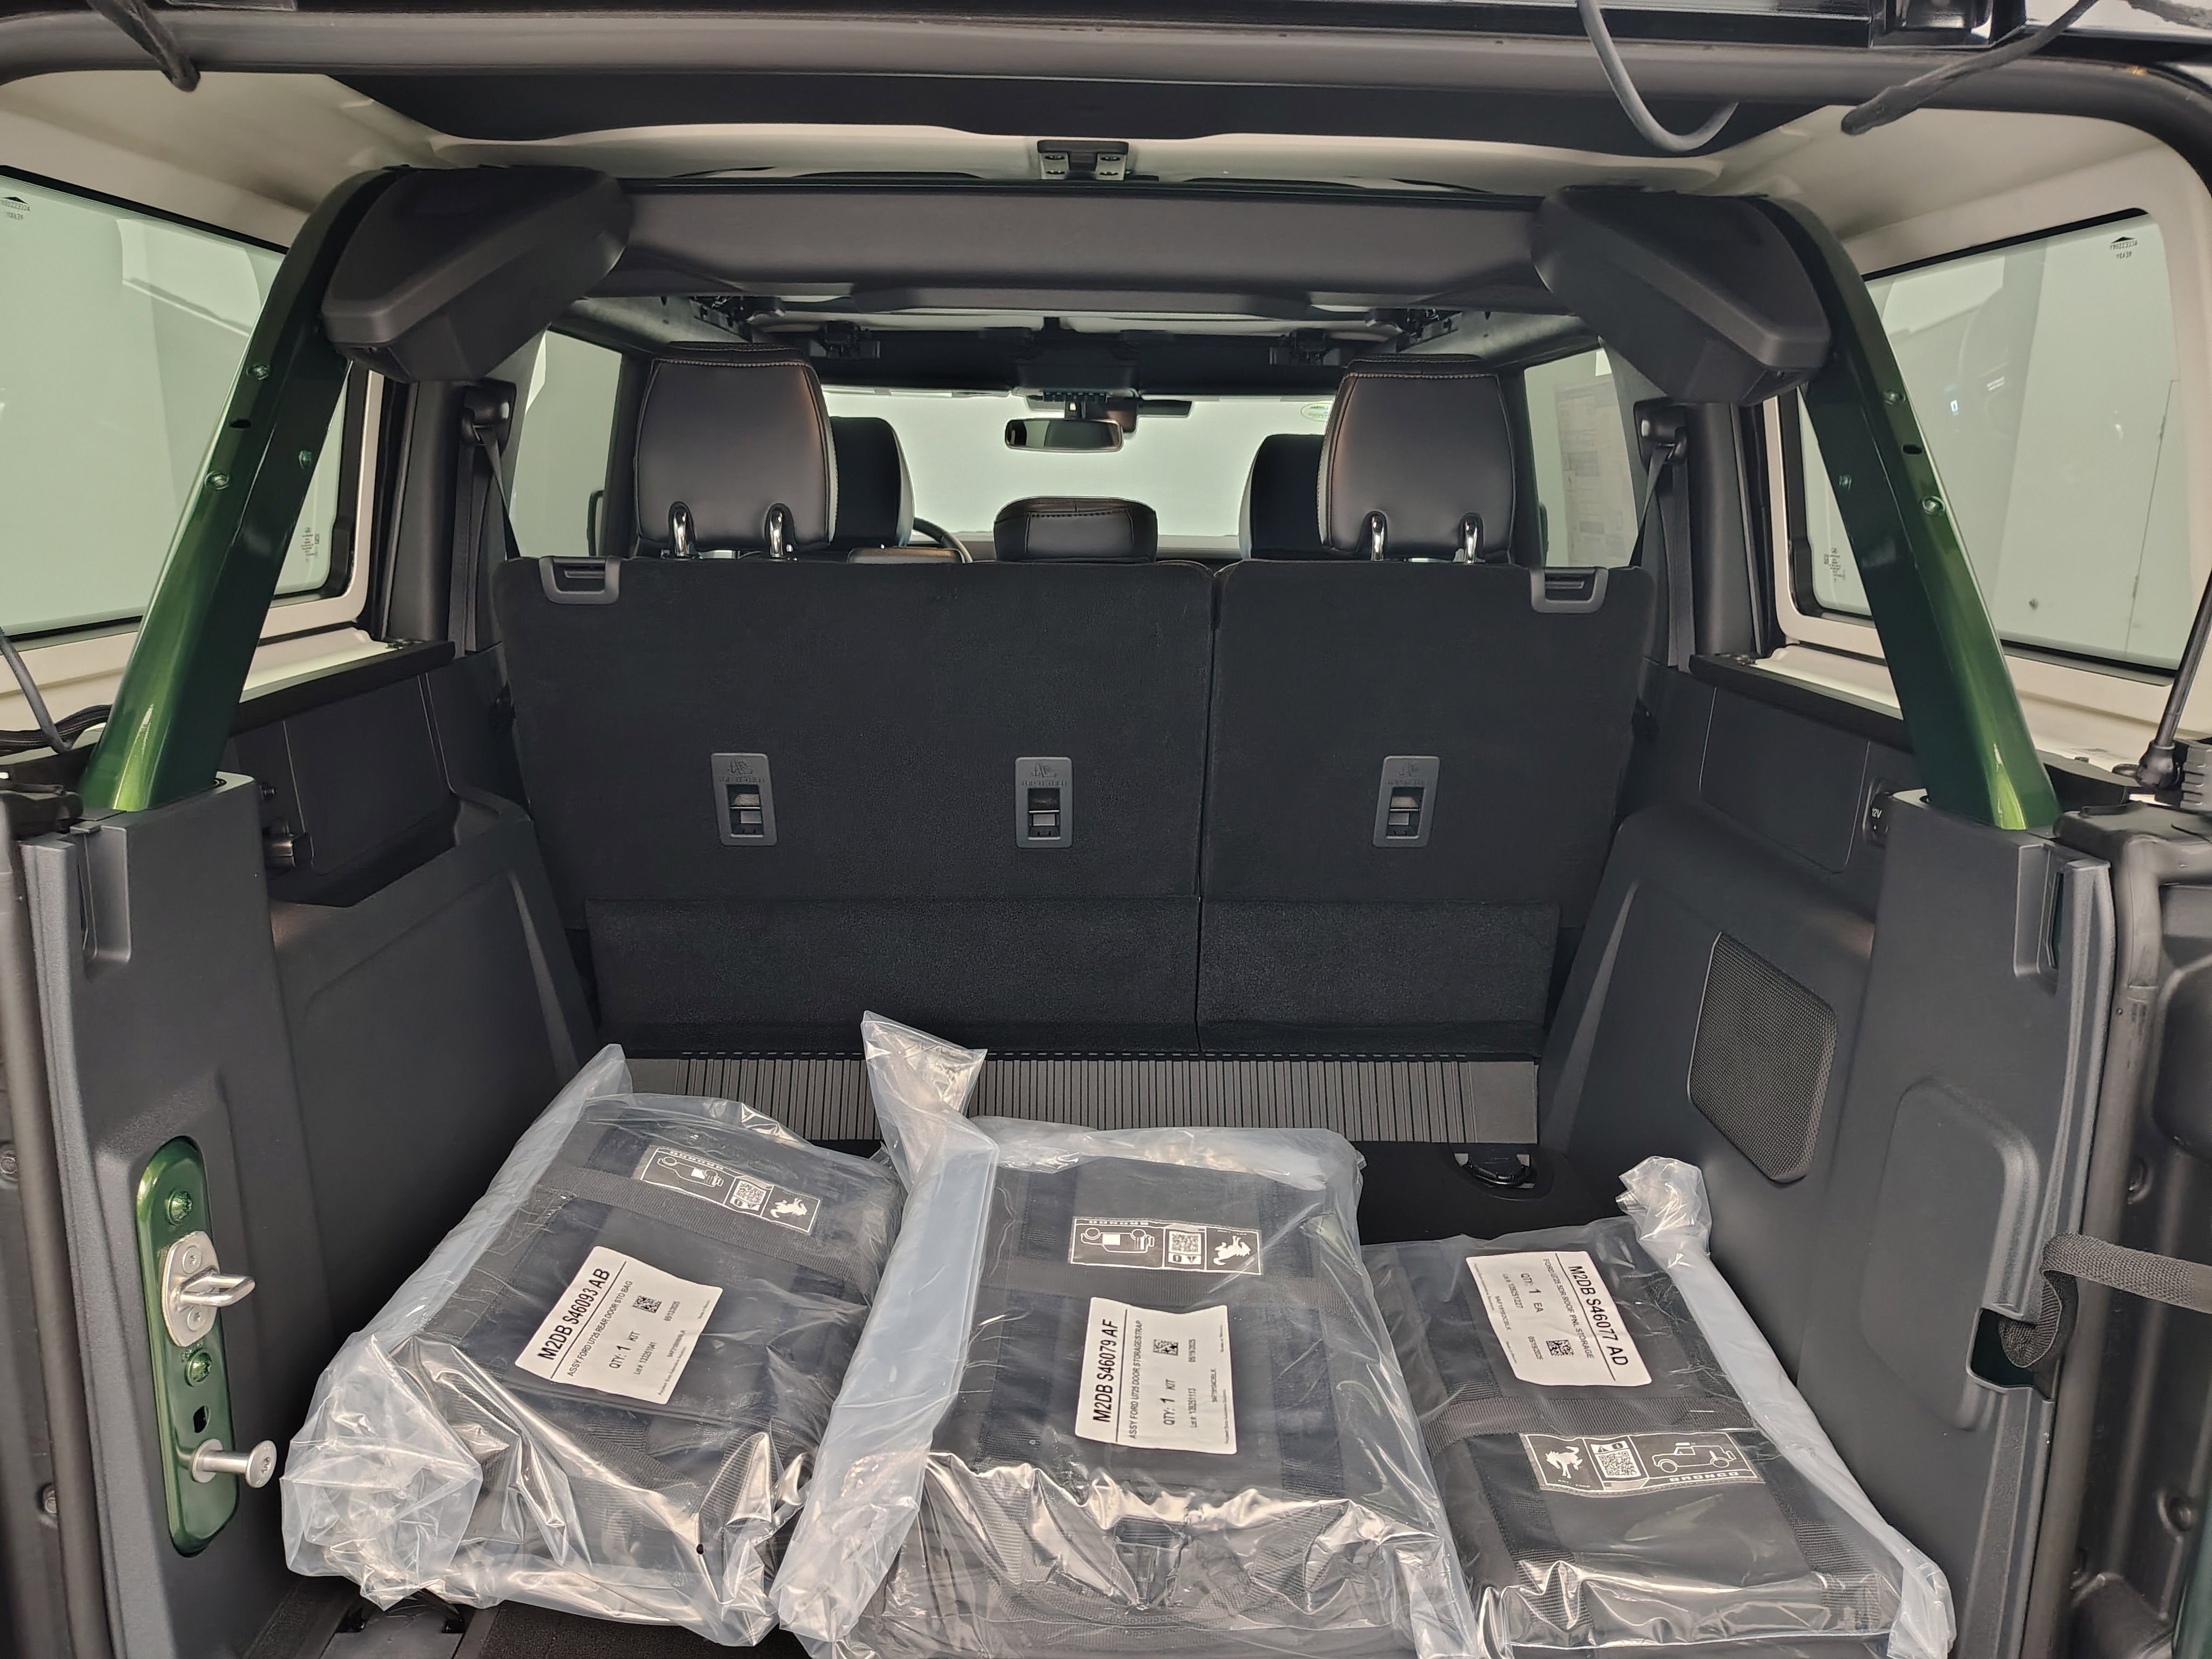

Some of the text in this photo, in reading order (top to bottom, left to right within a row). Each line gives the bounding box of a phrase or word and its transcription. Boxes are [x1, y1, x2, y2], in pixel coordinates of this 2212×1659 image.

[1872, 808, 1882, 818] 12V
[537, 1269, 610, 1360] M2DB S46093 AB
[1533, 1302, 1543, 1312] EA
[1543, 1258, 1554, 1272] FORD
[1562, 1296, 1574, 1312] ROOF
[1570, 1314, 1579, 1327] PNL
[1575, 1328, 1594, 1358] STORAGE
[1568, 1266, 1628, 1365] M2DB S46077 AD
[567, 1359, 581, 1377] ASSY
[577, 1344, 591, 1360] FORD
[595, 1318, 609, 1332] REAR
[604, 1303, 619, 1318] DOOR
[614, 1292, 625, 1303] STO
[620, 1280, 632, 1292] BAG
[609, 1354, 626, 1368] QTY:
[627, 1331, 639, 1341] KIT
[1092, 1319, 1117, 1422] M2DB S46079 AF
[1131, 1367, 1140, 1385] DOOR
[1165, 1379, 1175, 1390] KIT
[1130, 1401, 1138, 1419] FORD
[1163, 1407, 1175, 1425] QTY:
[1128, 1420, 1137, 1439] ASSY
[1669, 1472, 1739, 1482] BRONCO
